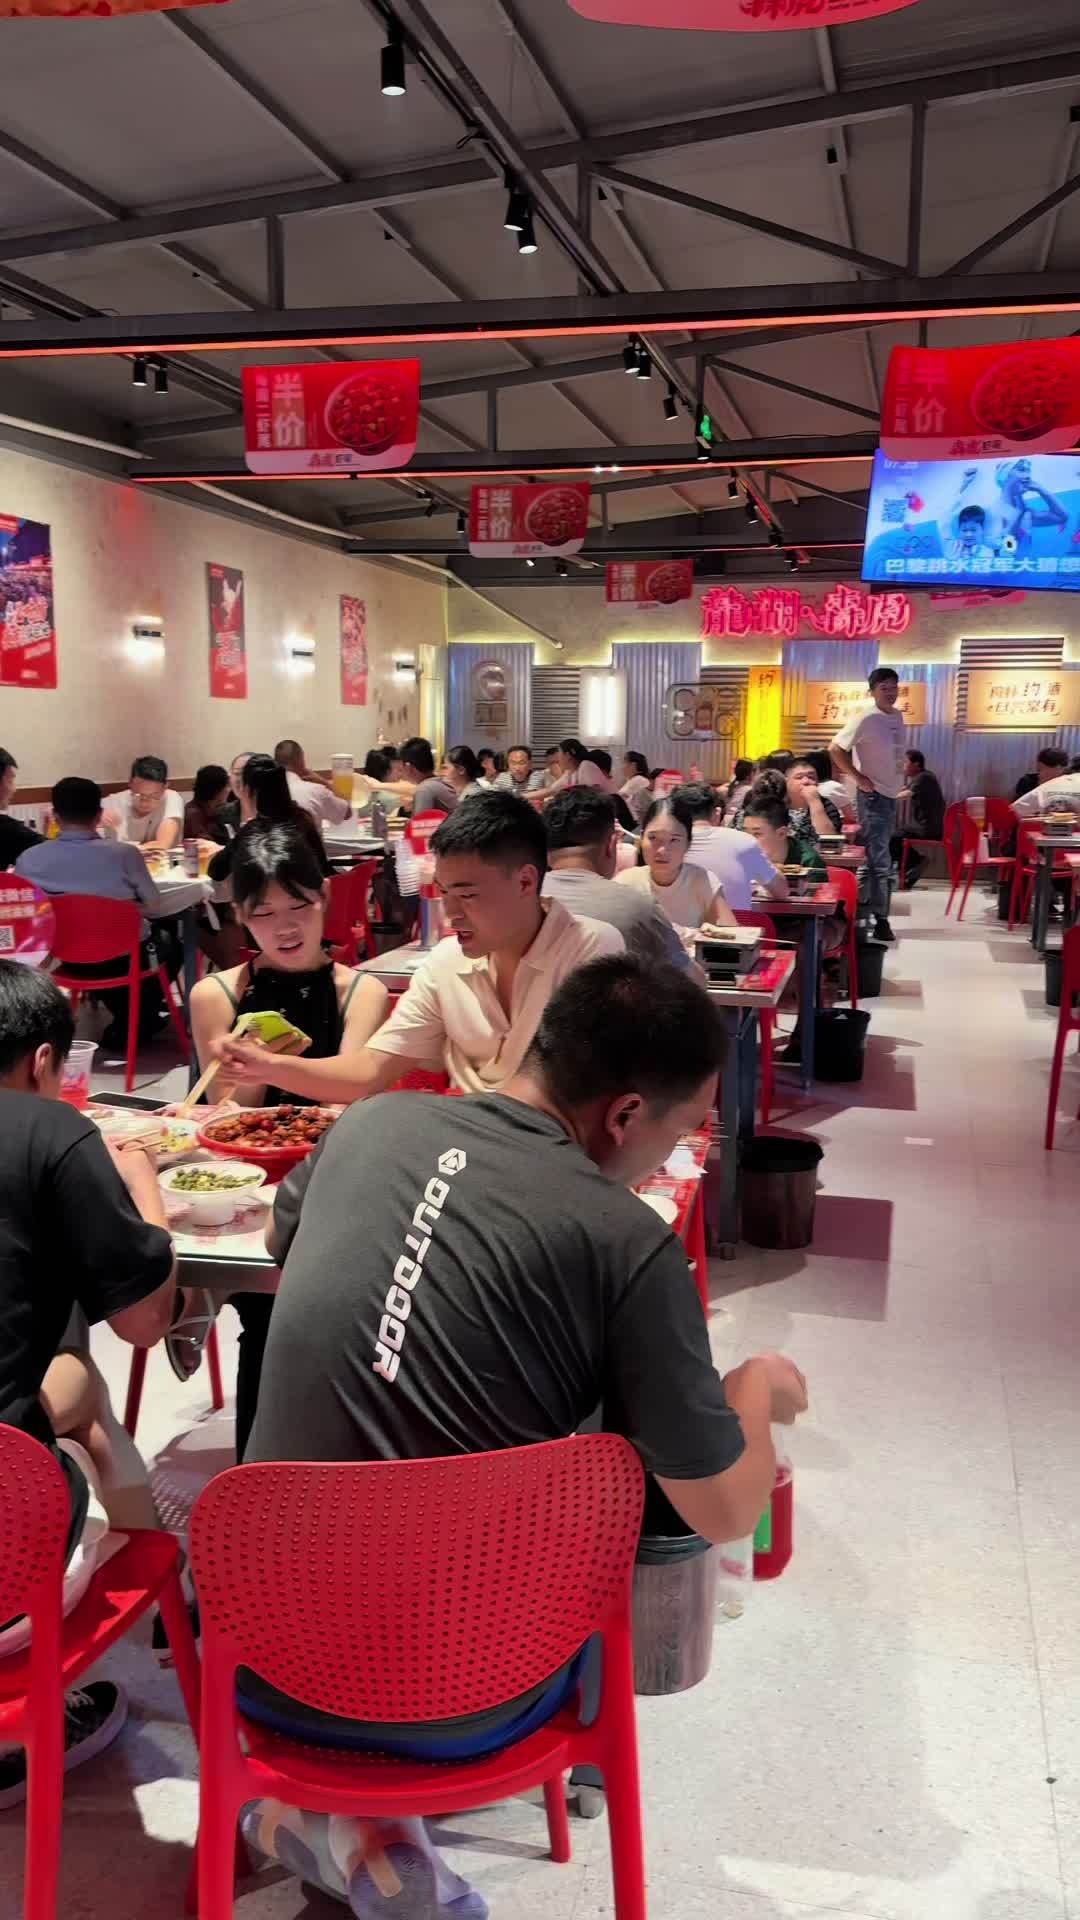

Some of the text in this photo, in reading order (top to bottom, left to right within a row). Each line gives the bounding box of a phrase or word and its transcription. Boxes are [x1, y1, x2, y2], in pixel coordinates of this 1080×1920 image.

[272, 373, 304, 448] 半价
[912, 353, 948, 433] 半价
[490, 488, 512, 539] 半价
[372, 1176, 451, 1384] OUTDOOR
